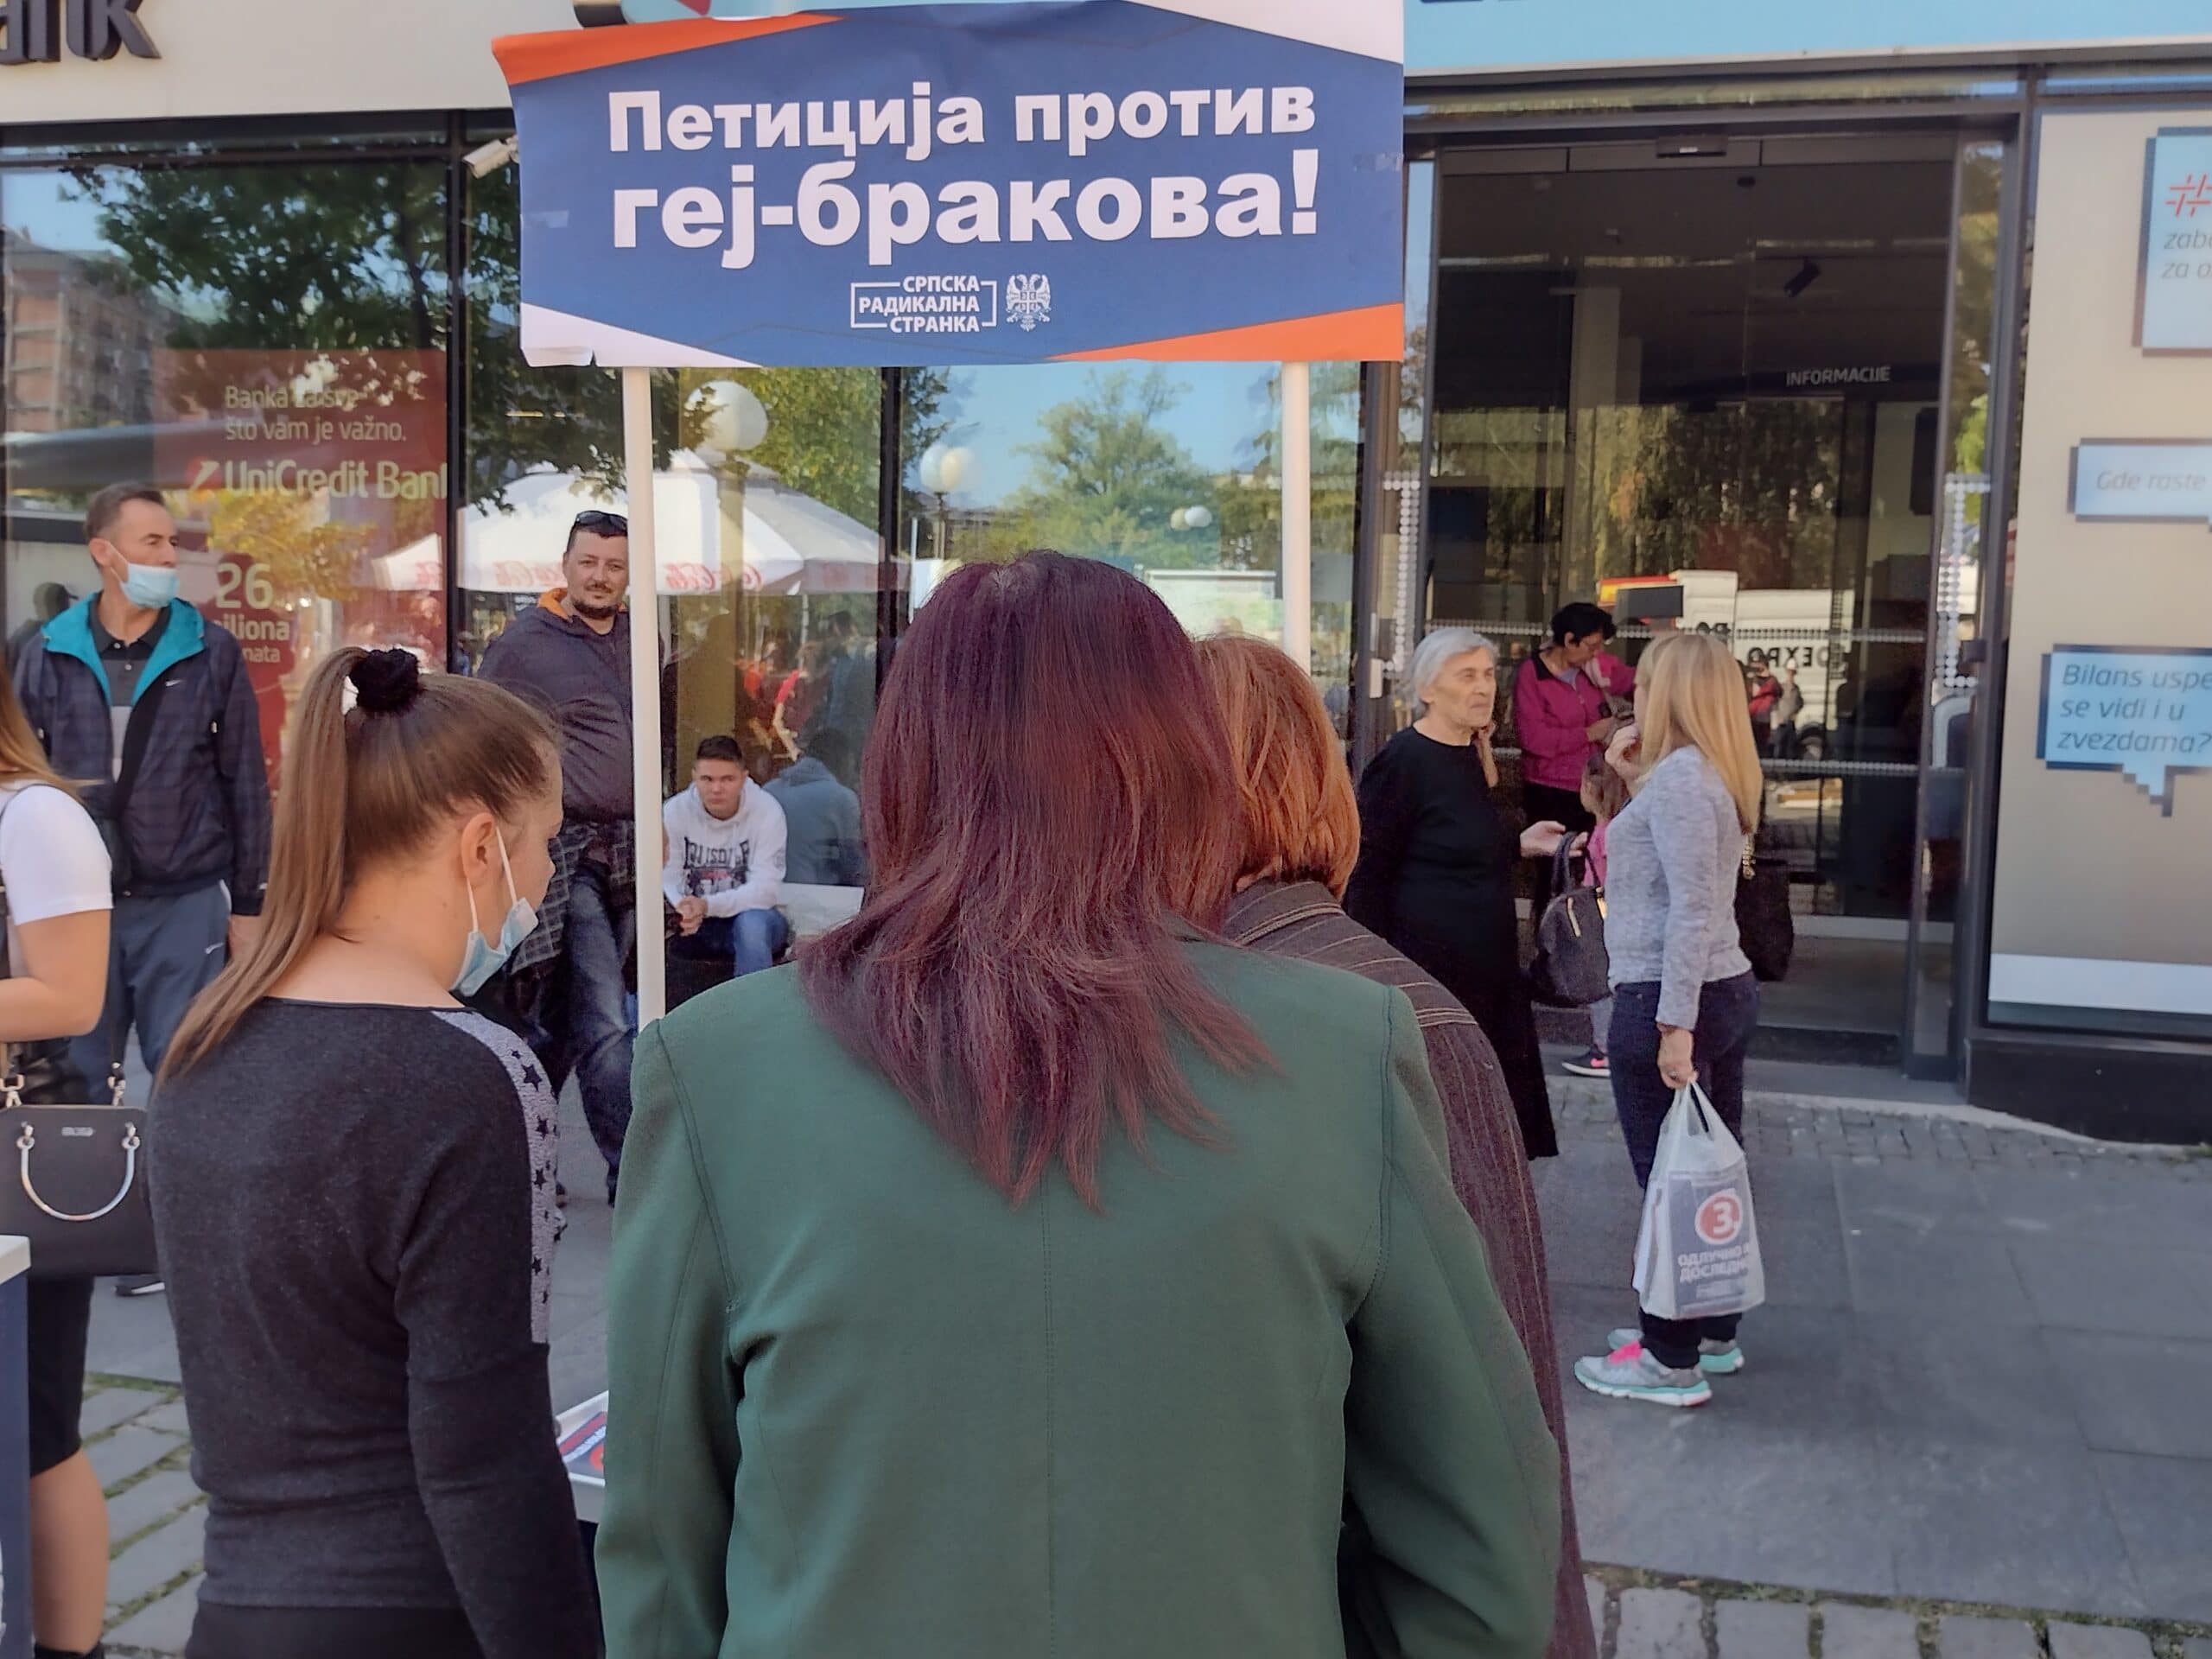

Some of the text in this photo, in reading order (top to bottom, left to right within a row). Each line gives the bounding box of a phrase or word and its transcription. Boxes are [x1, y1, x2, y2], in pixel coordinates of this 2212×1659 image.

[609, 81, 1315, 162] Петиција против
[614, 149, 1319, 270] геј-бракова!
[902, 276, 980, 293] СРПСКА
[858, 295, 980, 316] РАДИКАЛНА
[889, 315, 980, 334] СТРАНКА
[1785, 365, 1891, 386] INFORMACIJE
[225, 385, 288, 409] Banka
[226, 415, 407, 445] što vam je važno.
[225, 460, 369, 499] UniCredit
[2096, 471, 2141, 491] Gde
[216, 562, 274, 610] 26
[213, 613, 290, 641] iliona
[2063, 664, 2144, 689] Bilans
[2060, 697, 2185, 721] se vidi i u
[2056, 730, 2212, 753] zvezdama?
[1713, 1201, 1736, 1236] 3
